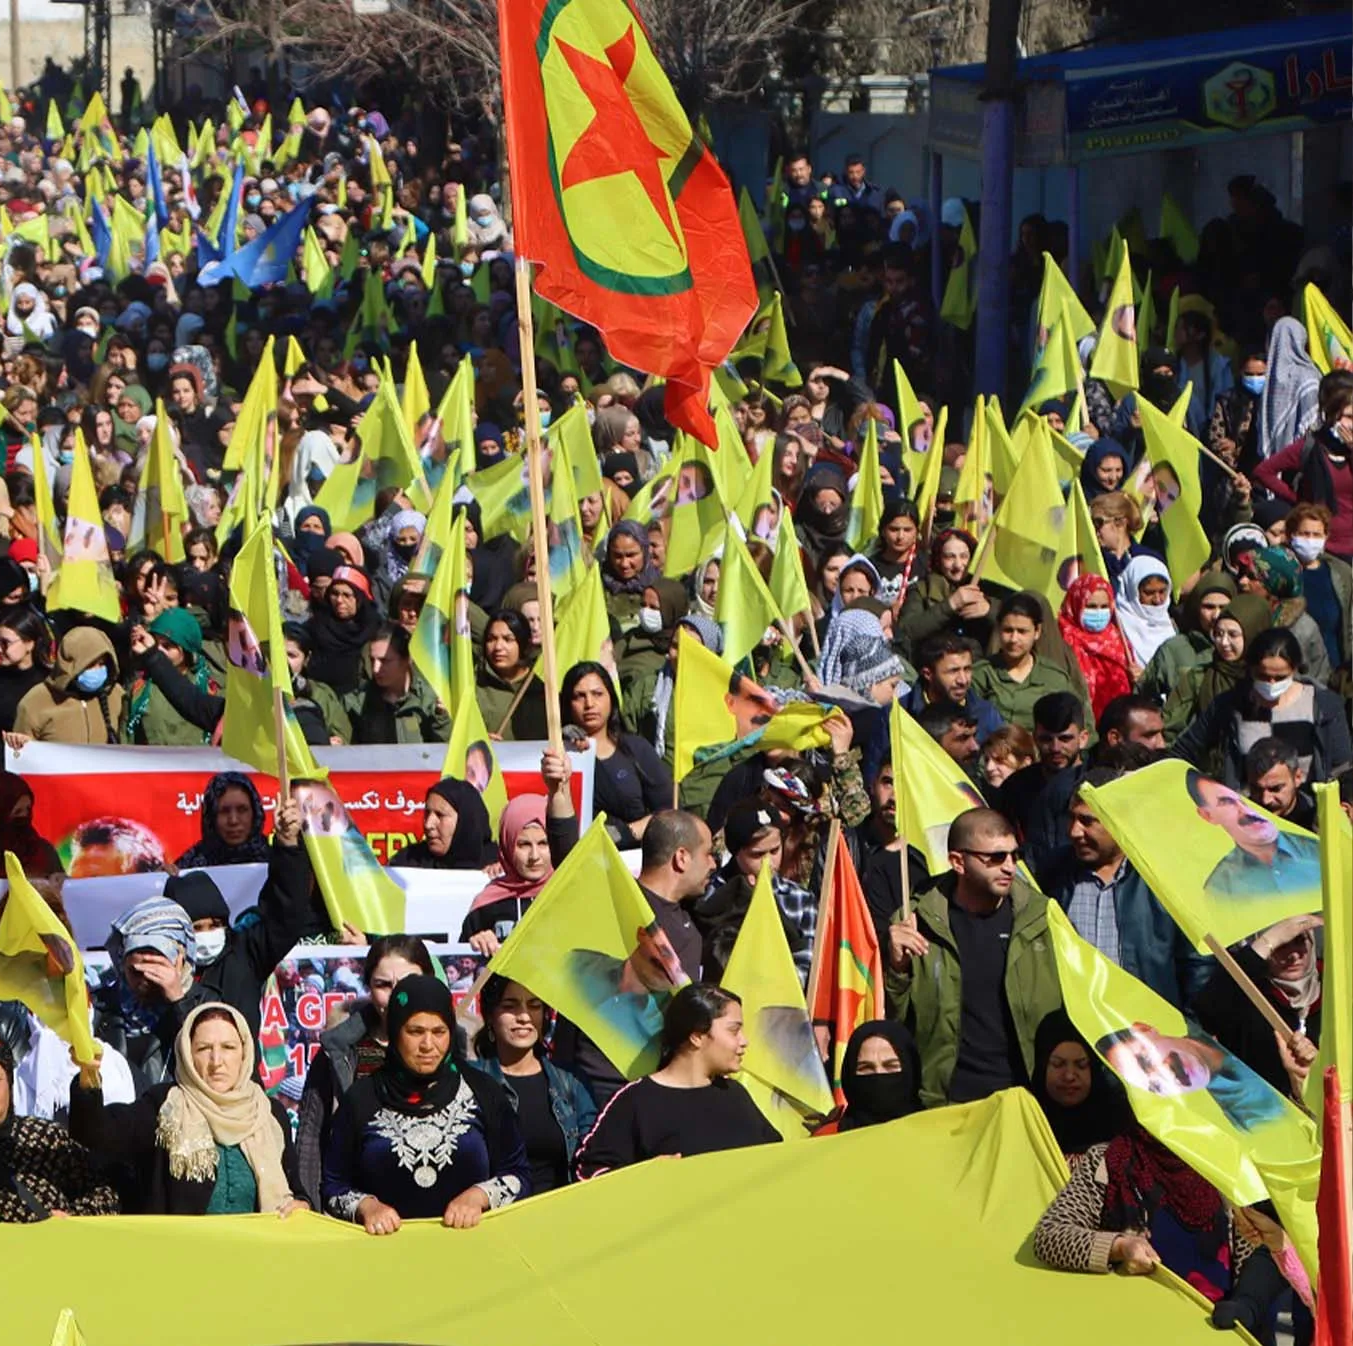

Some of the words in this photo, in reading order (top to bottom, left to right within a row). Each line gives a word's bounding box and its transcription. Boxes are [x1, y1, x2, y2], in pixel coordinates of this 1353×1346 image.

[1284, 47, 1352, 104] ارا
[1084, 128, 1181, 151] Pharmacy
[343, 790, 380, 810] نكس
